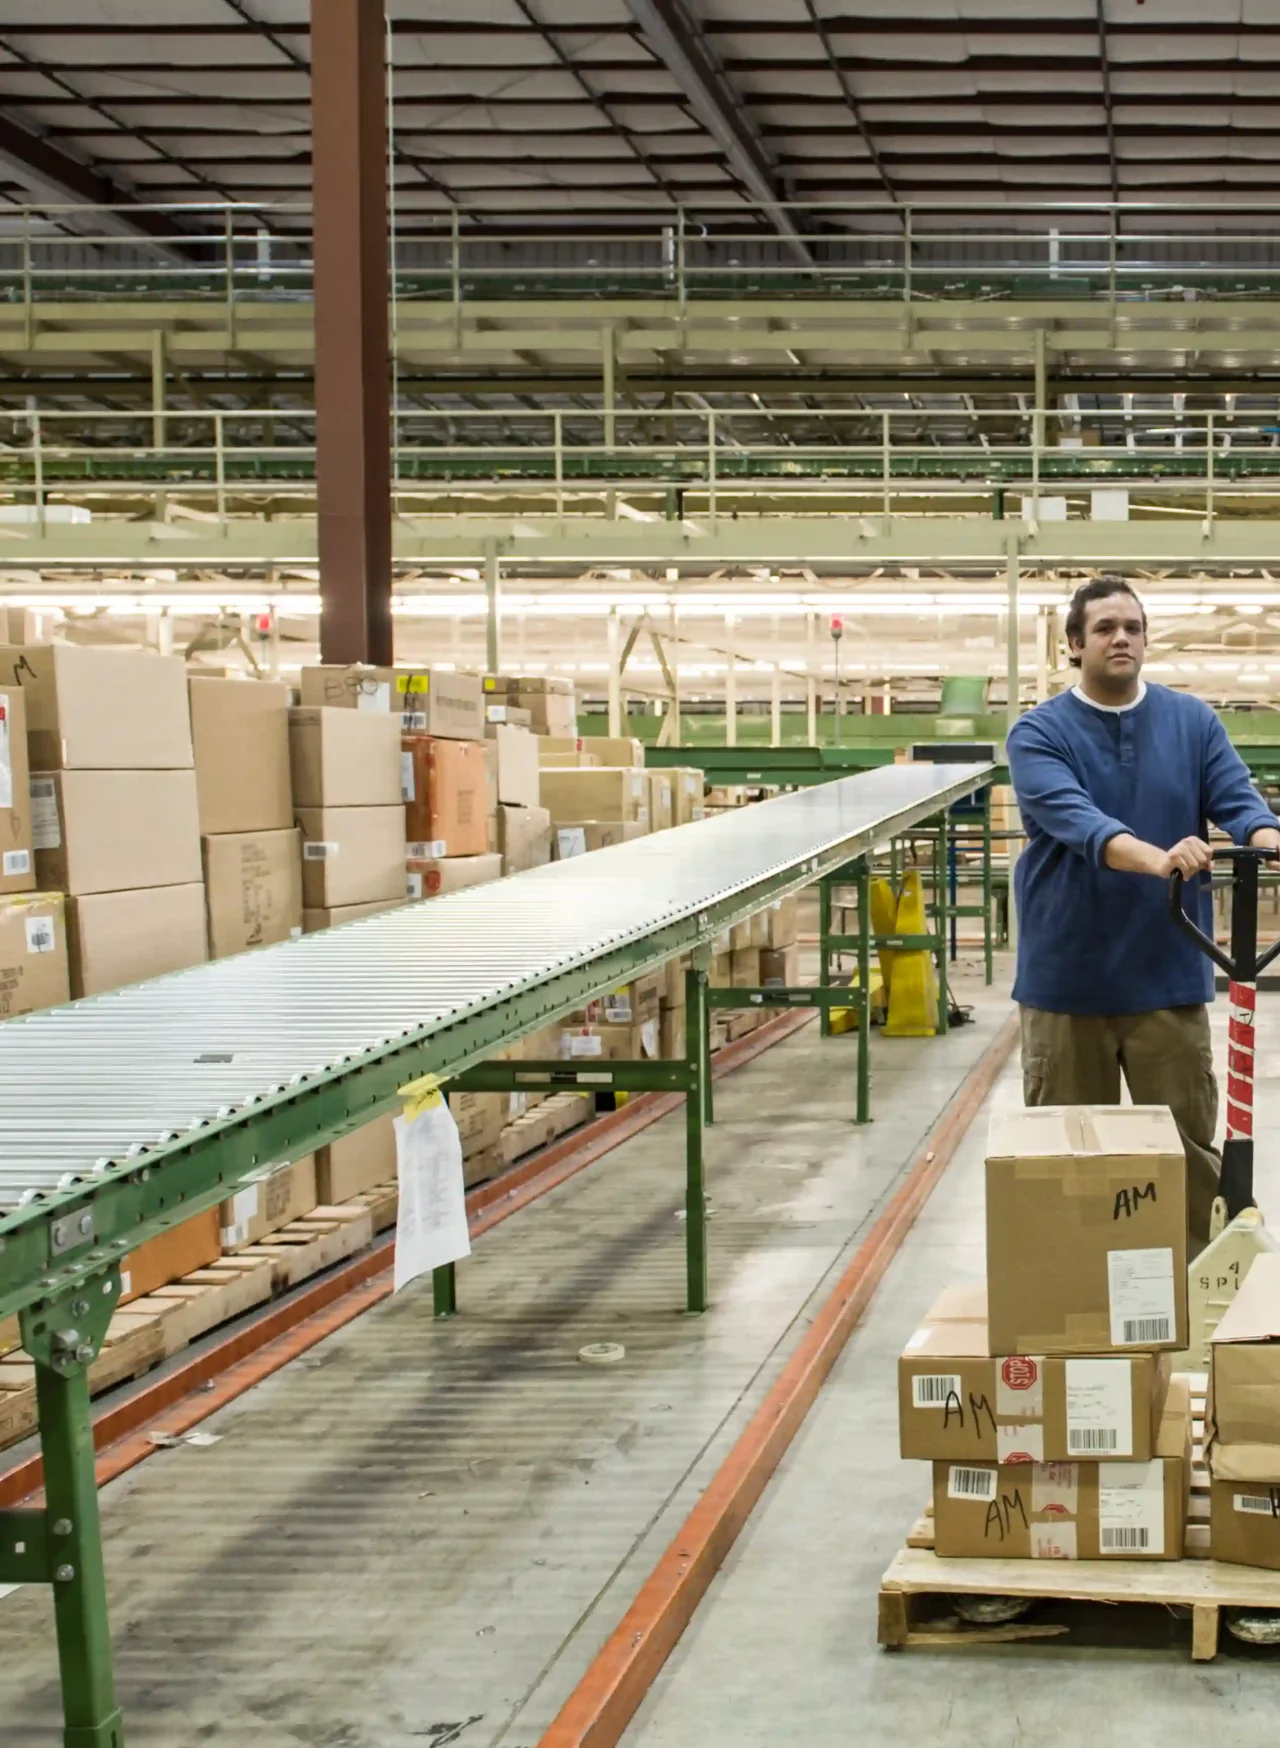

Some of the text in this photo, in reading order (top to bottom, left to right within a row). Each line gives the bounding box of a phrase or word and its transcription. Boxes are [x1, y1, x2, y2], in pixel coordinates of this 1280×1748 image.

[1113, 1182, 1157, 1221] AM
[1228, 1261, 1240, 1274] 4
[1009, 1359, 1031, 1385] STOP
[943, 1390, 998, 1440] AM
[984, 1488, 1029, 1541] AM
